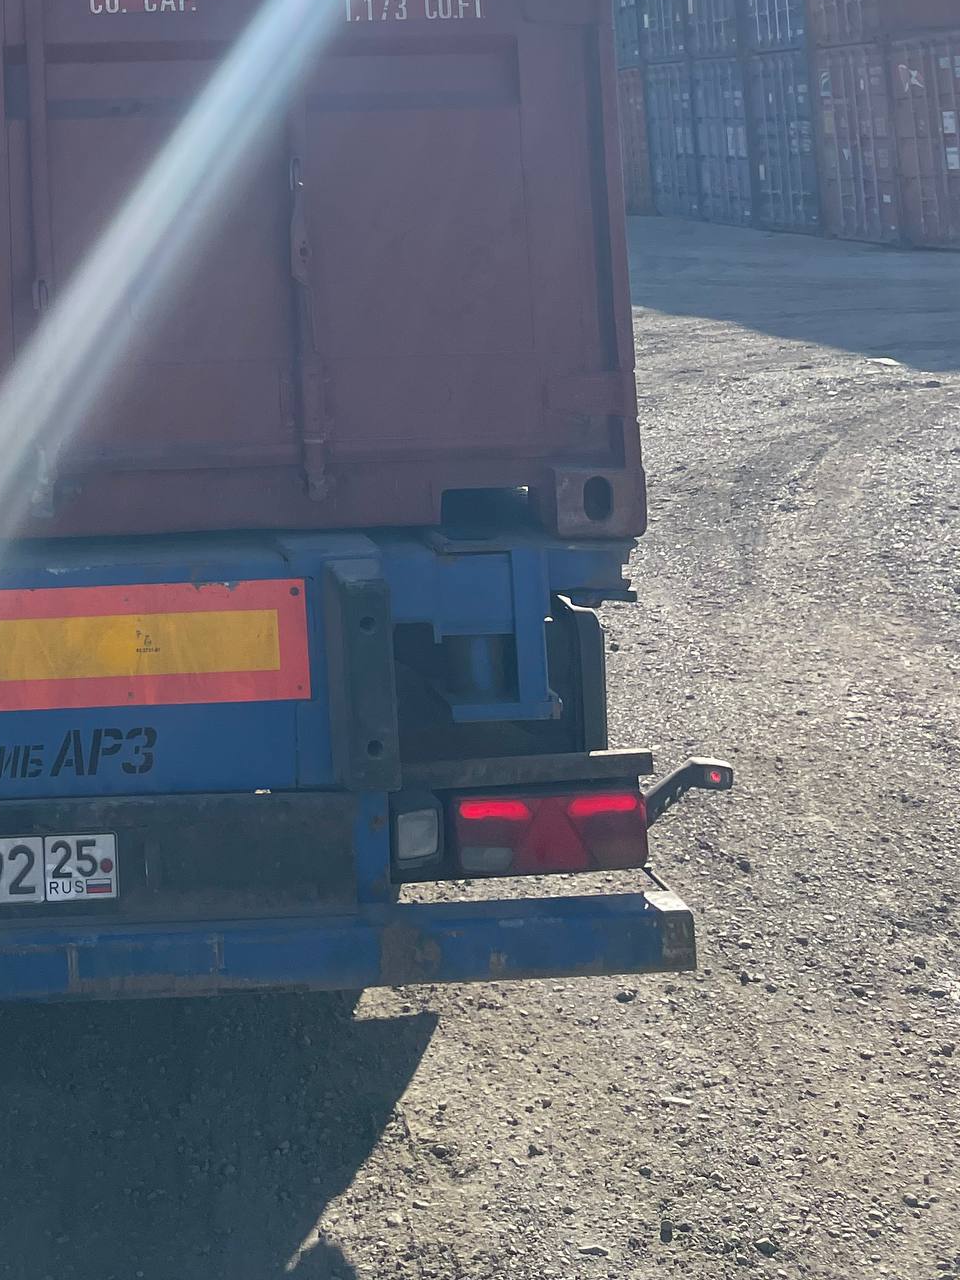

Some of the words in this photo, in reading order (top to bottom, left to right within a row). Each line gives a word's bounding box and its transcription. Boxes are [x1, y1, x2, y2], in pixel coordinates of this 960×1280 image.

[49, 726, 158, 777] АРЗ
[50, 838, 98, 880] 25
[48, 878, 85, 896] RUS
